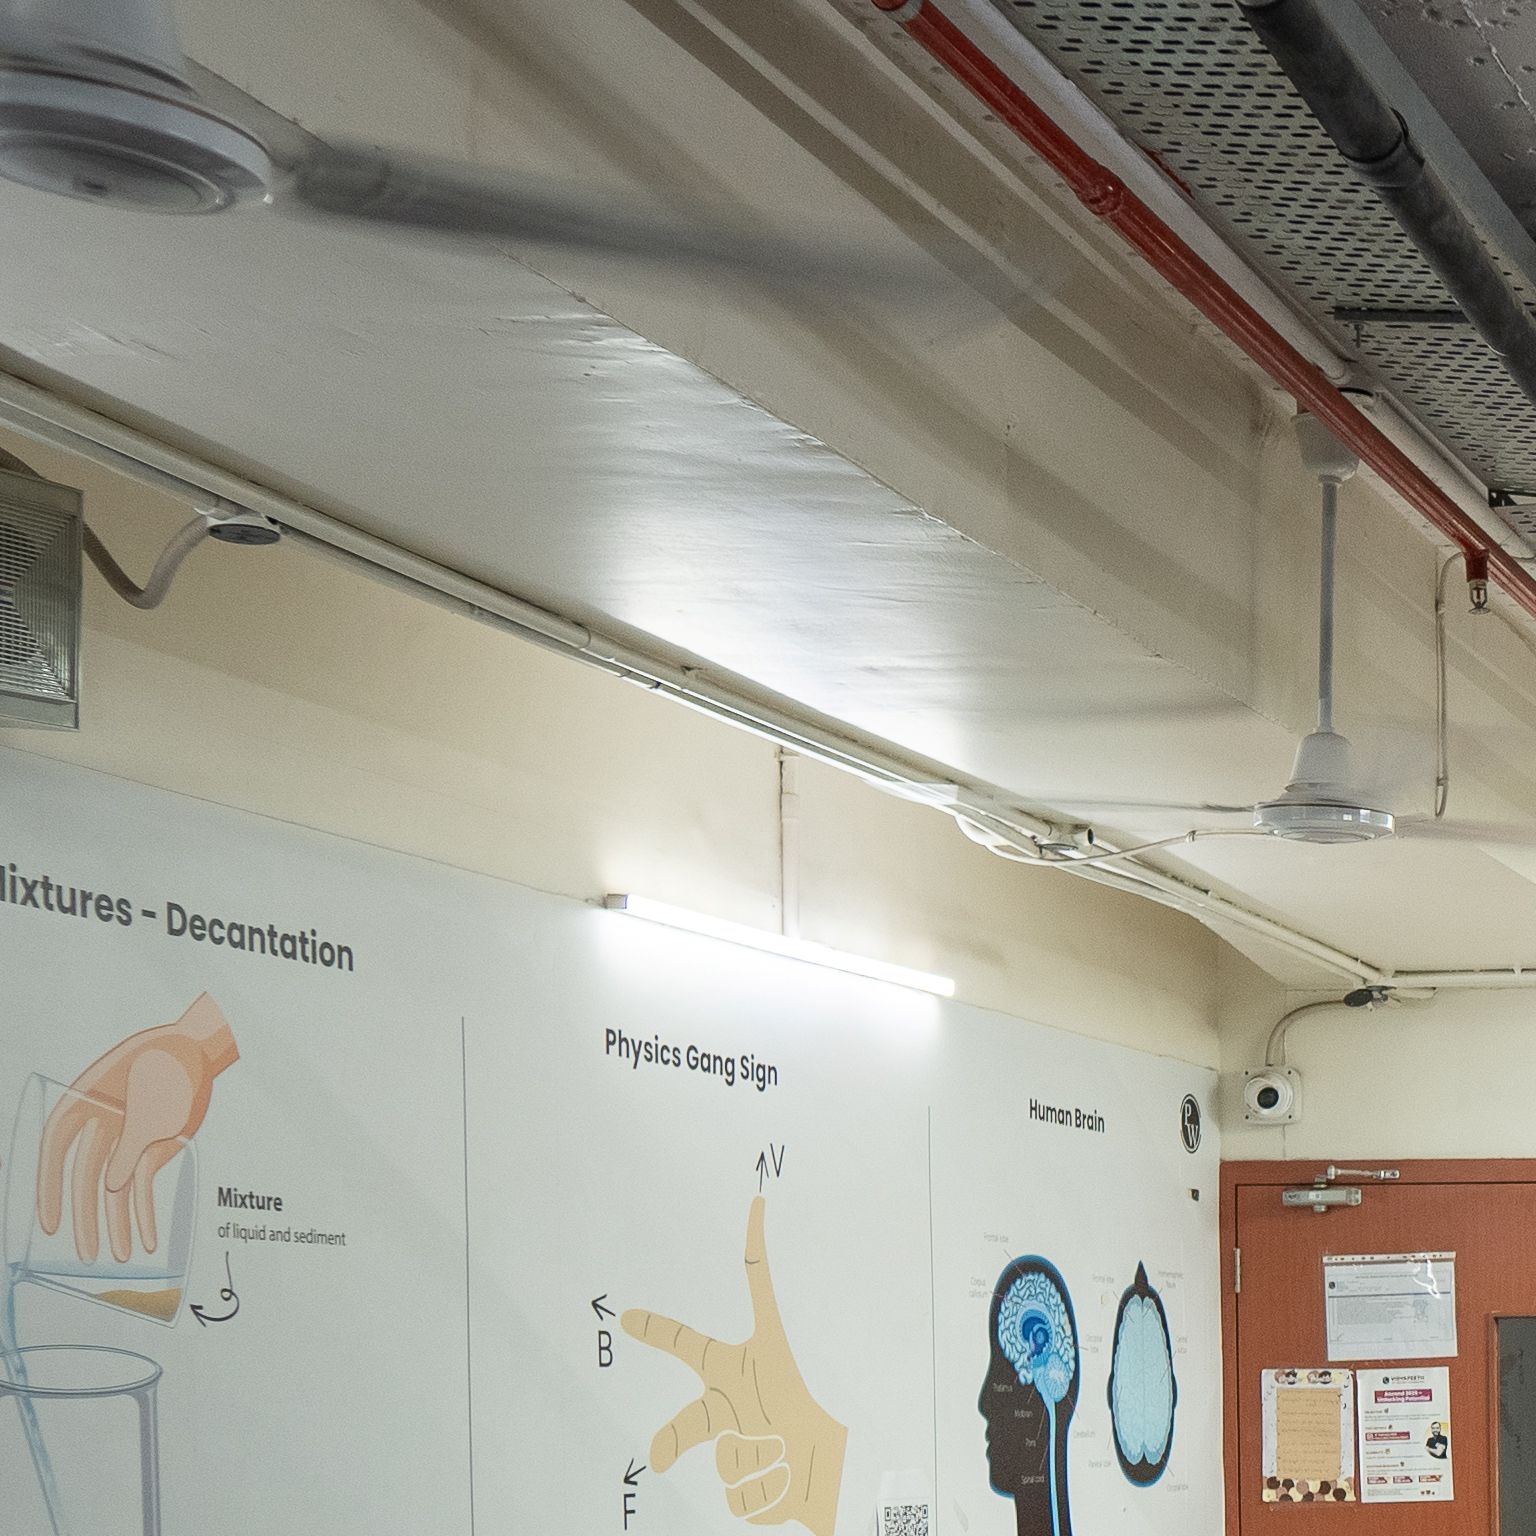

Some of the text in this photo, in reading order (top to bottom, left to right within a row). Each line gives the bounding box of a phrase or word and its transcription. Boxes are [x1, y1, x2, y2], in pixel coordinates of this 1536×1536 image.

[166, 901, 354, 972] Decantation
[605, 1028, 778, 1092] Physics Gang Sign
[1029, 1098, 1105, 1133] Human Brain
[217, 1186, 283, 1212] Mixture
[218, 1222, 346, 1246] of liquid and sediment
[597, 1331, 613, 1367] B
[623, 1492, 637, 1530] F
